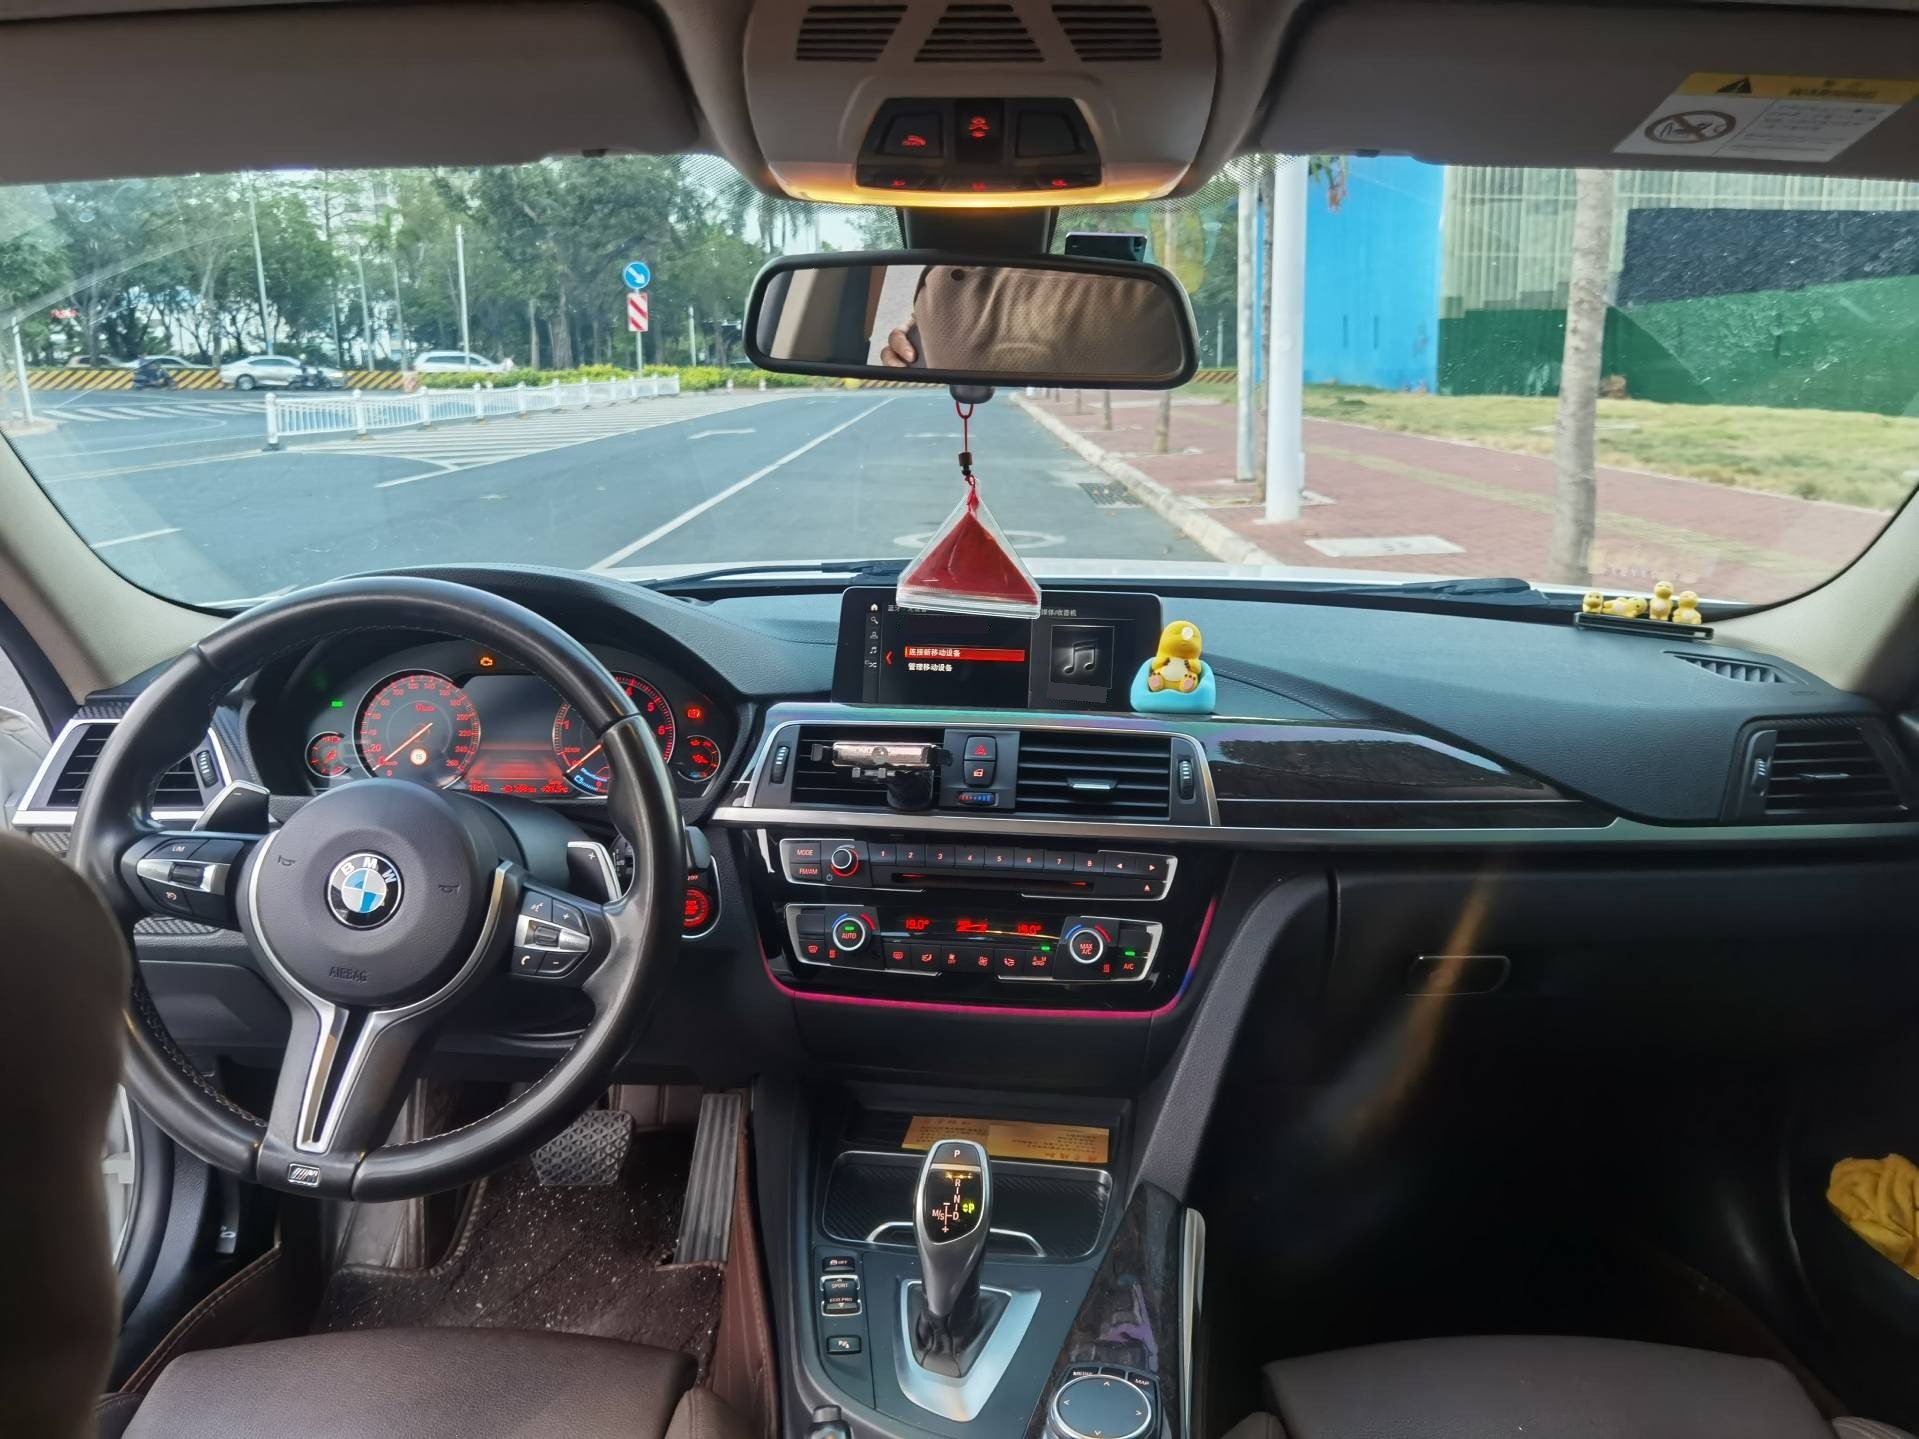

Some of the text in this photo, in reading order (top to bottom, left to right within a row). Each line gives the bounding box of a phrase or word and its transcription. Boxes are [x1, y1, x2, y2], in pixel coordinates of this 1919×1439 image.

[796, 848, 814, 856] MODE
[340, 856, 398, 884] BMW
[841, 932, 857, 940] AUTO
[1123, 962, 1135, 970] A/C
[329, 966, 367, 982] AIRBAG
[954, 1149, 960, 1158] P
[953, 1195, 961, 1203] N
[932, 1209, 959, 1220] M/S D
